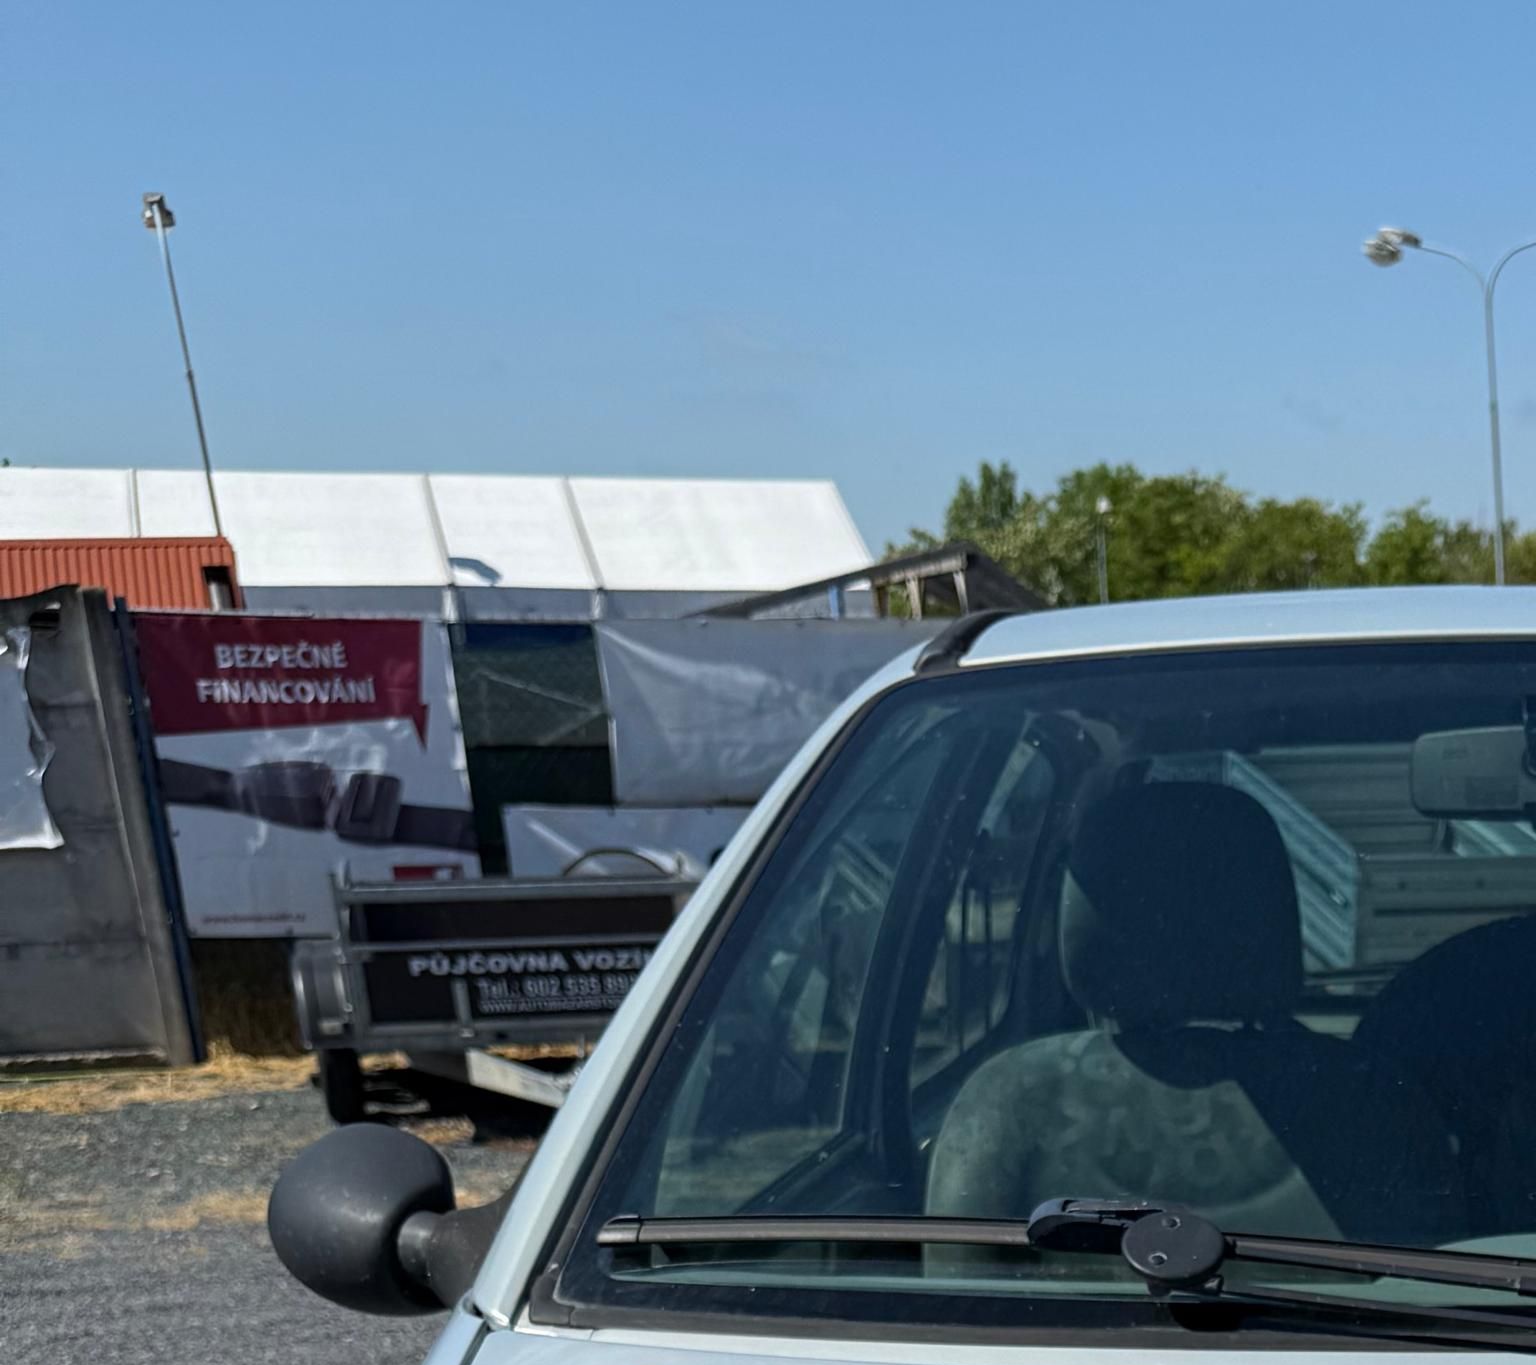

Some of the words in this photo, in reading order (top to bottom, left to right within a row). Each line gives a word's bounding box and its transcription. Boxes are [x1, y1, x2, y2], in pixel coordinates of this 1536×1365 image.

[214, 640, 348, 669] BEZPEČNÉ
[196, 675, 376, 704] FINANCOVÁNÍ
[407, 947, 570, 977] PŮJČOVNA
